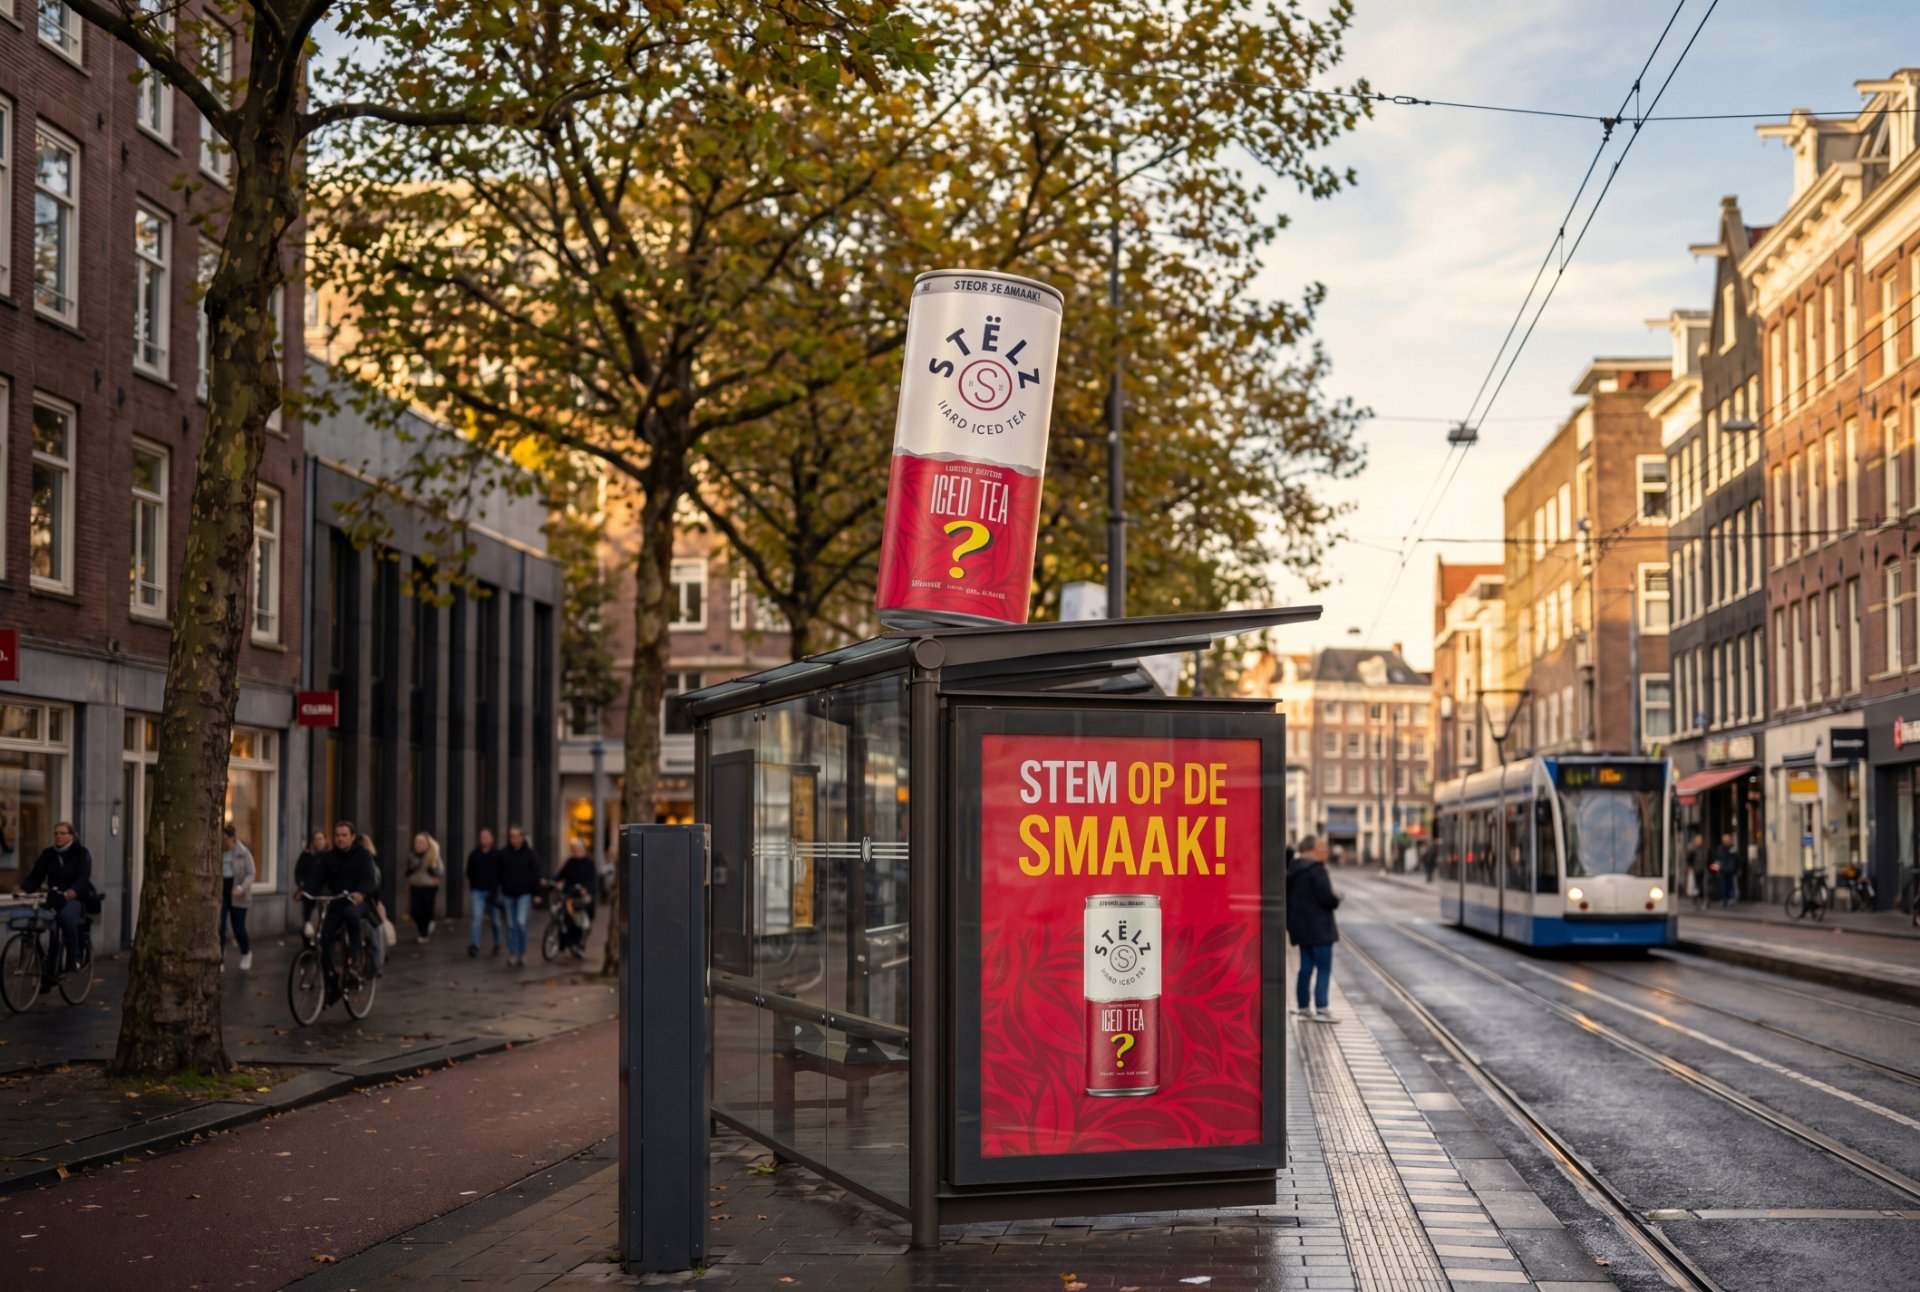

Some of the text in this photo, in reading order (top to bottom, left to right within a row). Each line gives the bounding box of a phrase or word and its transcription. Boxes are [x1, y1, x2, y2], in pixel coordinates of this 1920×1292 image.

[928, 315, 1041, 389] STËLZ
[971, 423, 1004, 435] ICED
[1006, 409, 1027, 430] TEA
[930, 474, 1009, 525] ICED TEA
[1020, 759, 1228, 805] STEM OP DE
[1018, 814, 1227, 877] SMAAK!
[1094, 919, 1152, 957] STËLZ
[1101, 1008, 1145, 1032] ICED TEA
